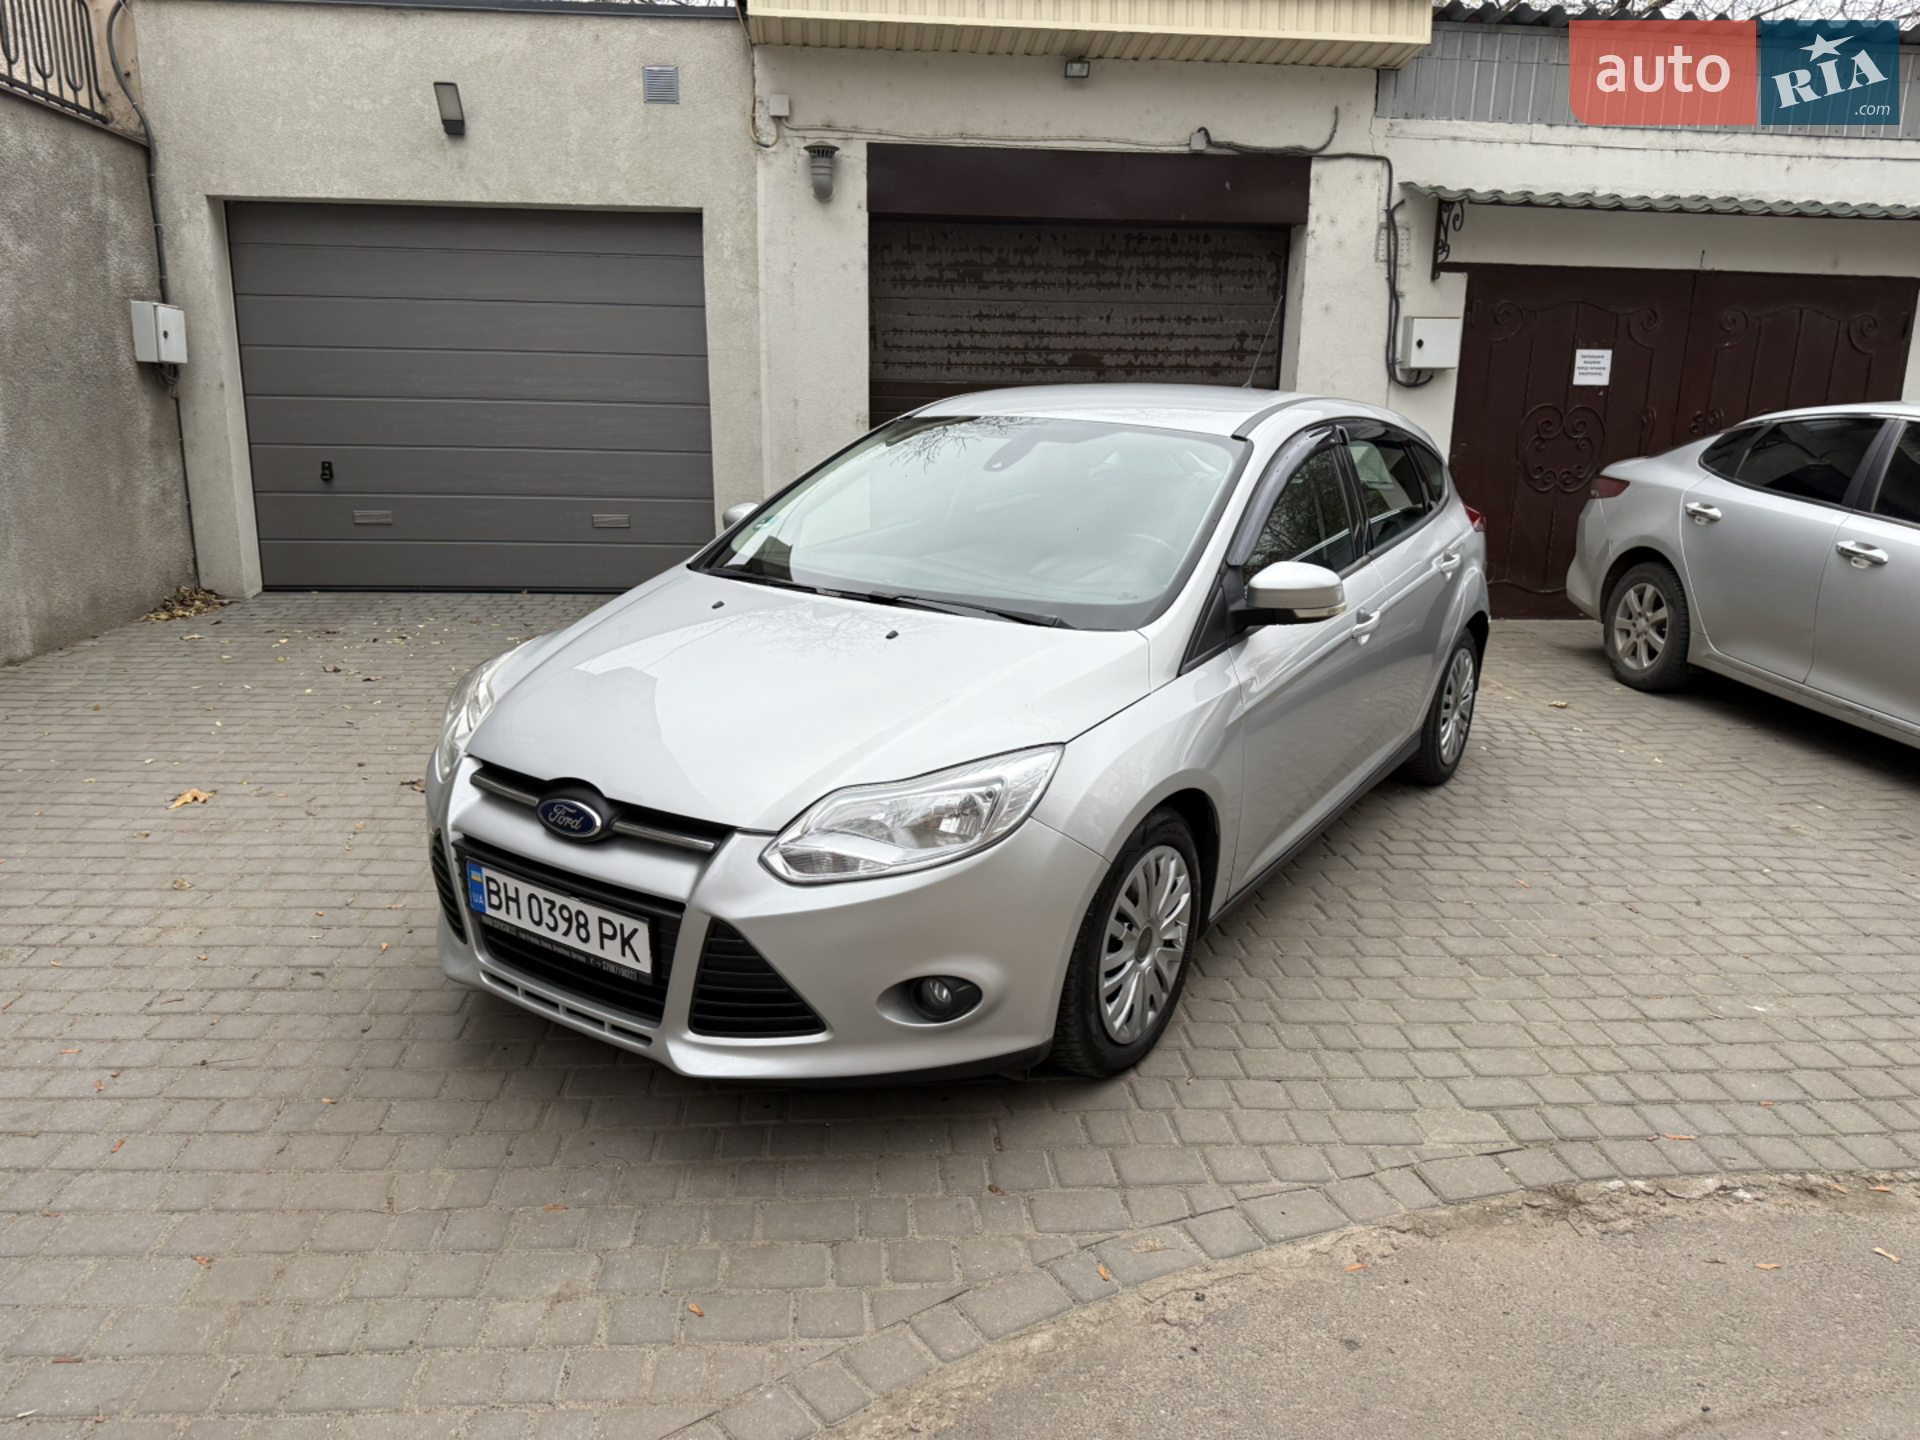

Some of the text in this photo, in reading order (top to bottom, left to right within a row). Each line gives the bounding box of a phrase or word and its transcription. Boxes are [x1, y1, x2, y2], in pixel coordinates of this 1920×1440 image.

[548, 804, 584, 830] Ford
[472, 892, 484, 905] UA
[485, 875, 522, 920] BH
[527, 892, 591, 944] 0398
[598, 915, 641, 963] PK
